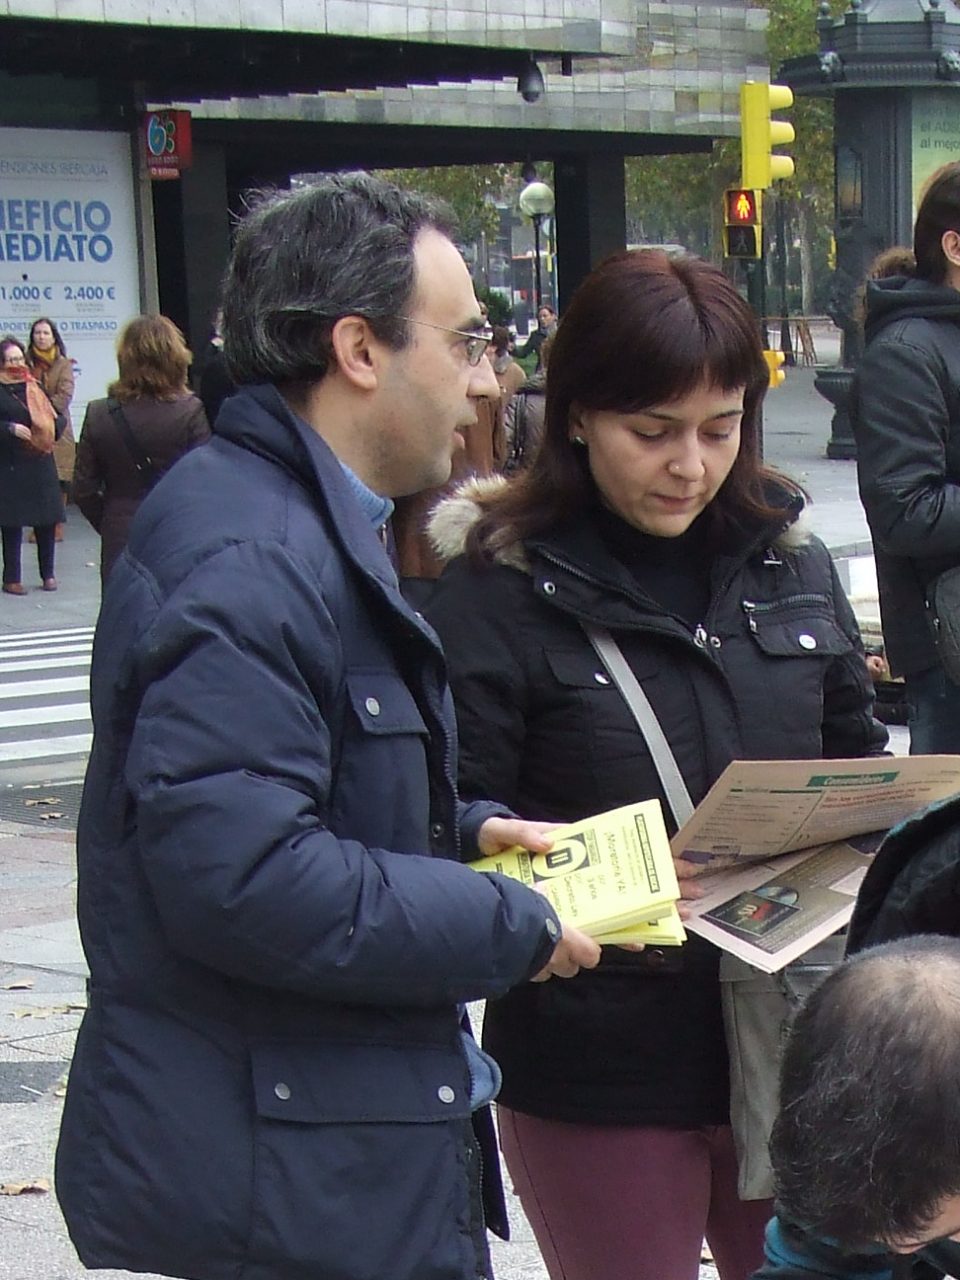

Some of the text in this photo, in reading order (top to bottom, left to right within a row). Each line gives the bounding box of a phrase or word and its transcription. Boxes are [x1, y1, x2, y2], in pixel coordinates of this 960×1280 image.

[0, 160, 56, 175] ENSIONES
[0, 233, 113, 263] EDIATO
[63, 286, 104, 300] 2.400
